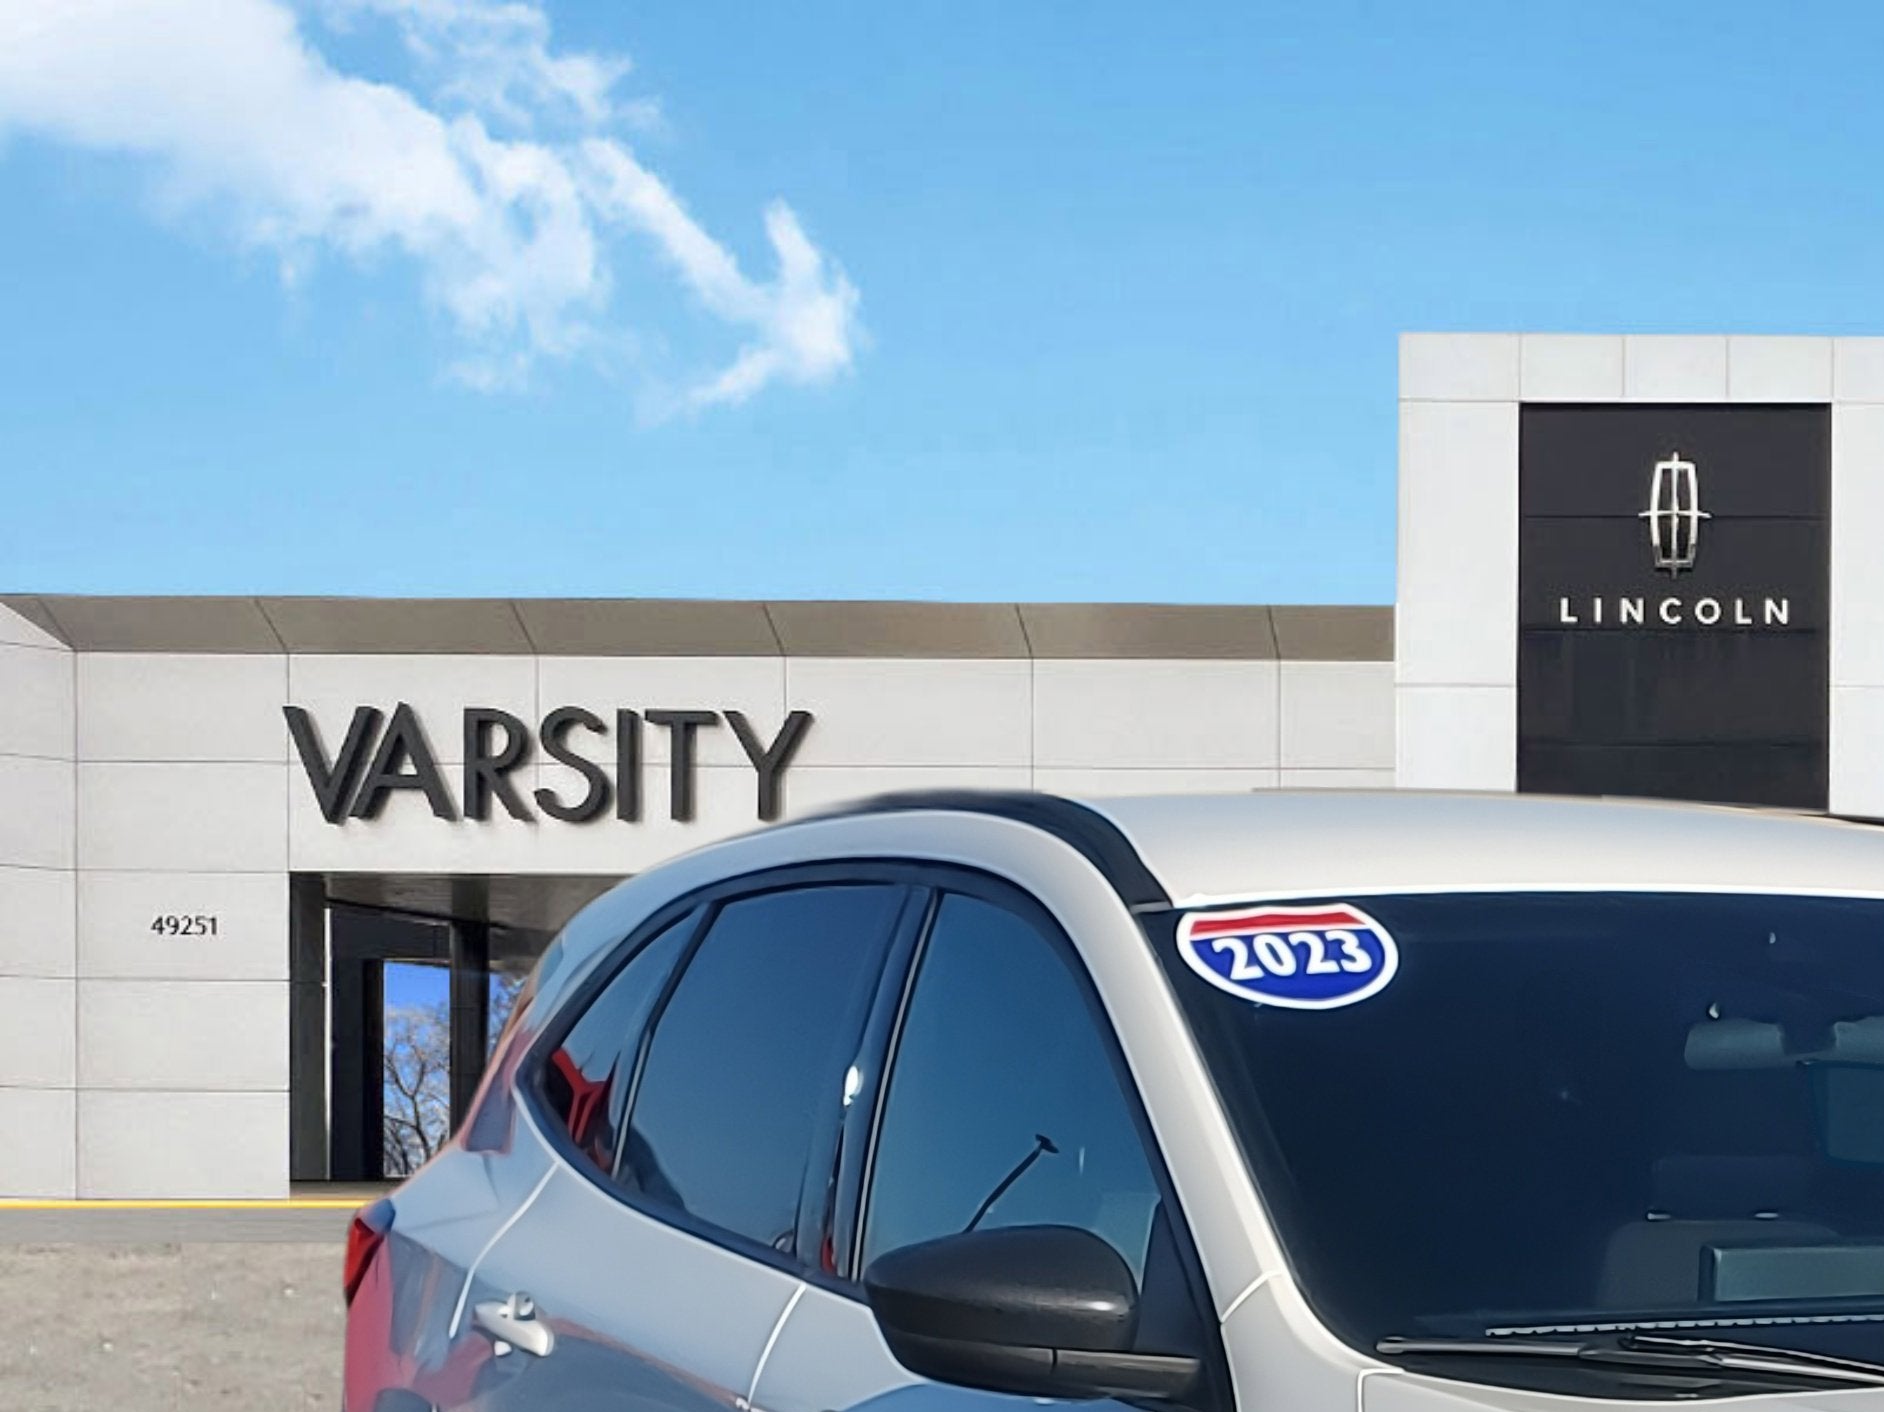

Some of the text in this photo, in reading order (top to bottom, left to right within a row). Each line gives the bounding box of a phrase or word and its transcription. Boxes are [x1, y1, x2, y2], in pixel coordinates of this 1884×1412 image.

[1559, 597, 1790, 625] LINCOLN
[283, 702, 812, 825] VARSITY
[150, 914, 218, 936] 49251
[1211, 929, 1373, 980] 2023
